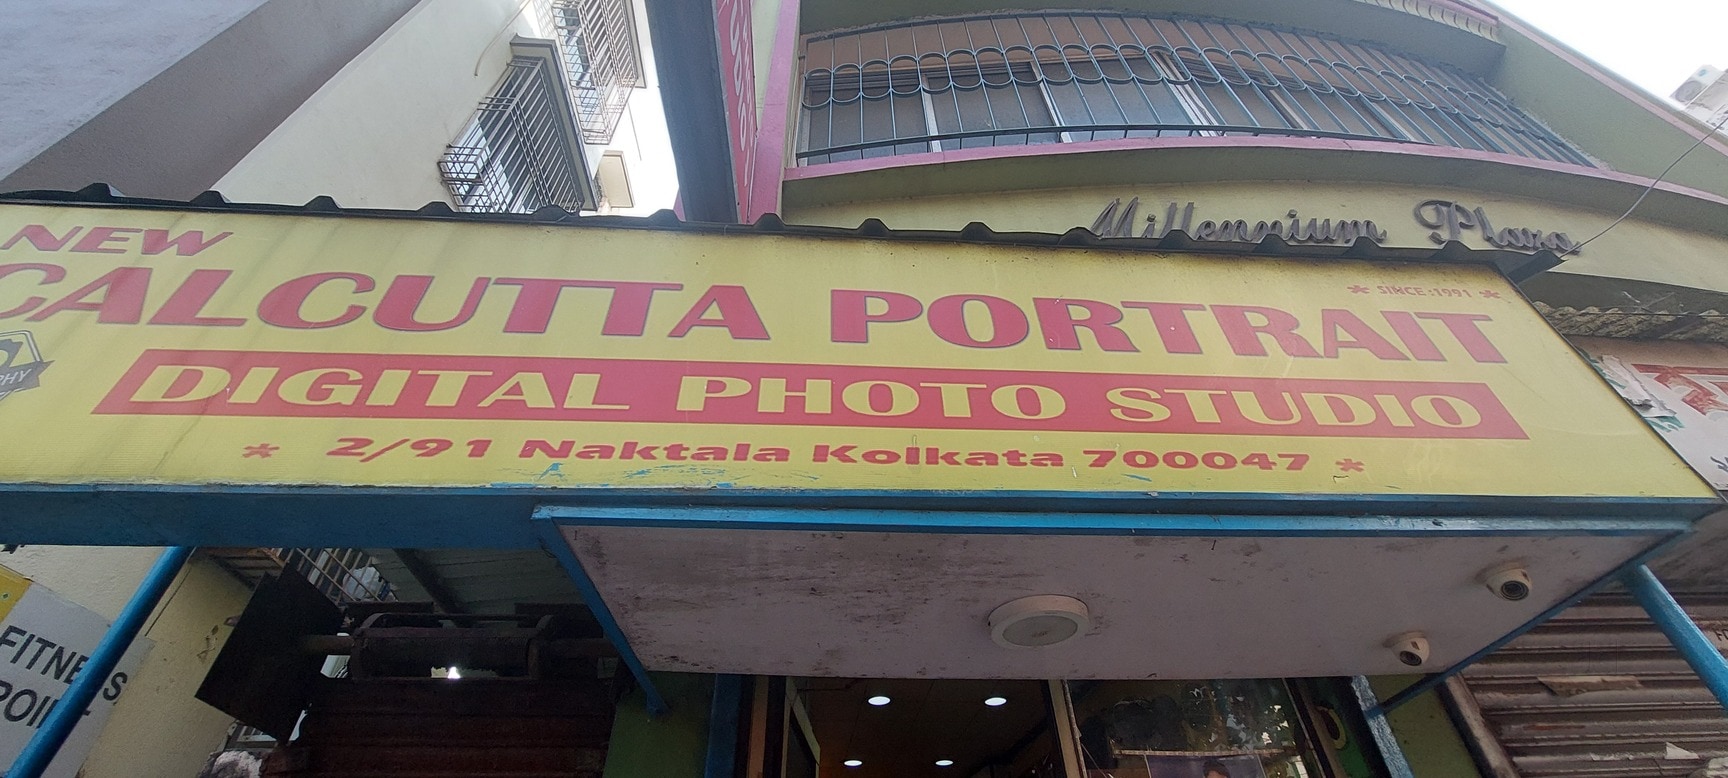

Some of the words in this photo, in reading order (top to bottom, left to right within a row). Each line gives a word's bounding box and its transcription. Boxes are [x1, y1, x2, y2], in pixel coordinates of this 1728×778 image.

[1, 224, 234, 256] NEW
[1091, 196, 1387, 246] Millennium
[0, 262, 771, 340] CALCUTTA
[830, 288, 1508, 364] PORTRAIT
[1377, 285, 1427, 297] SINCE
[128, 364, 631, 410] DIGITAL
[676, 375, 1067, 420] PHOTO
[1106, 386, 1483, 429] STUDIO
[326, 437, 492, 462] 2/91
[518, 439, 791, 462] Naktala
[812, 444, 1065, 468] Kolkata
[1082, 449, 1310, 471] 700047
[0, 625, 128, 701] FITNES
